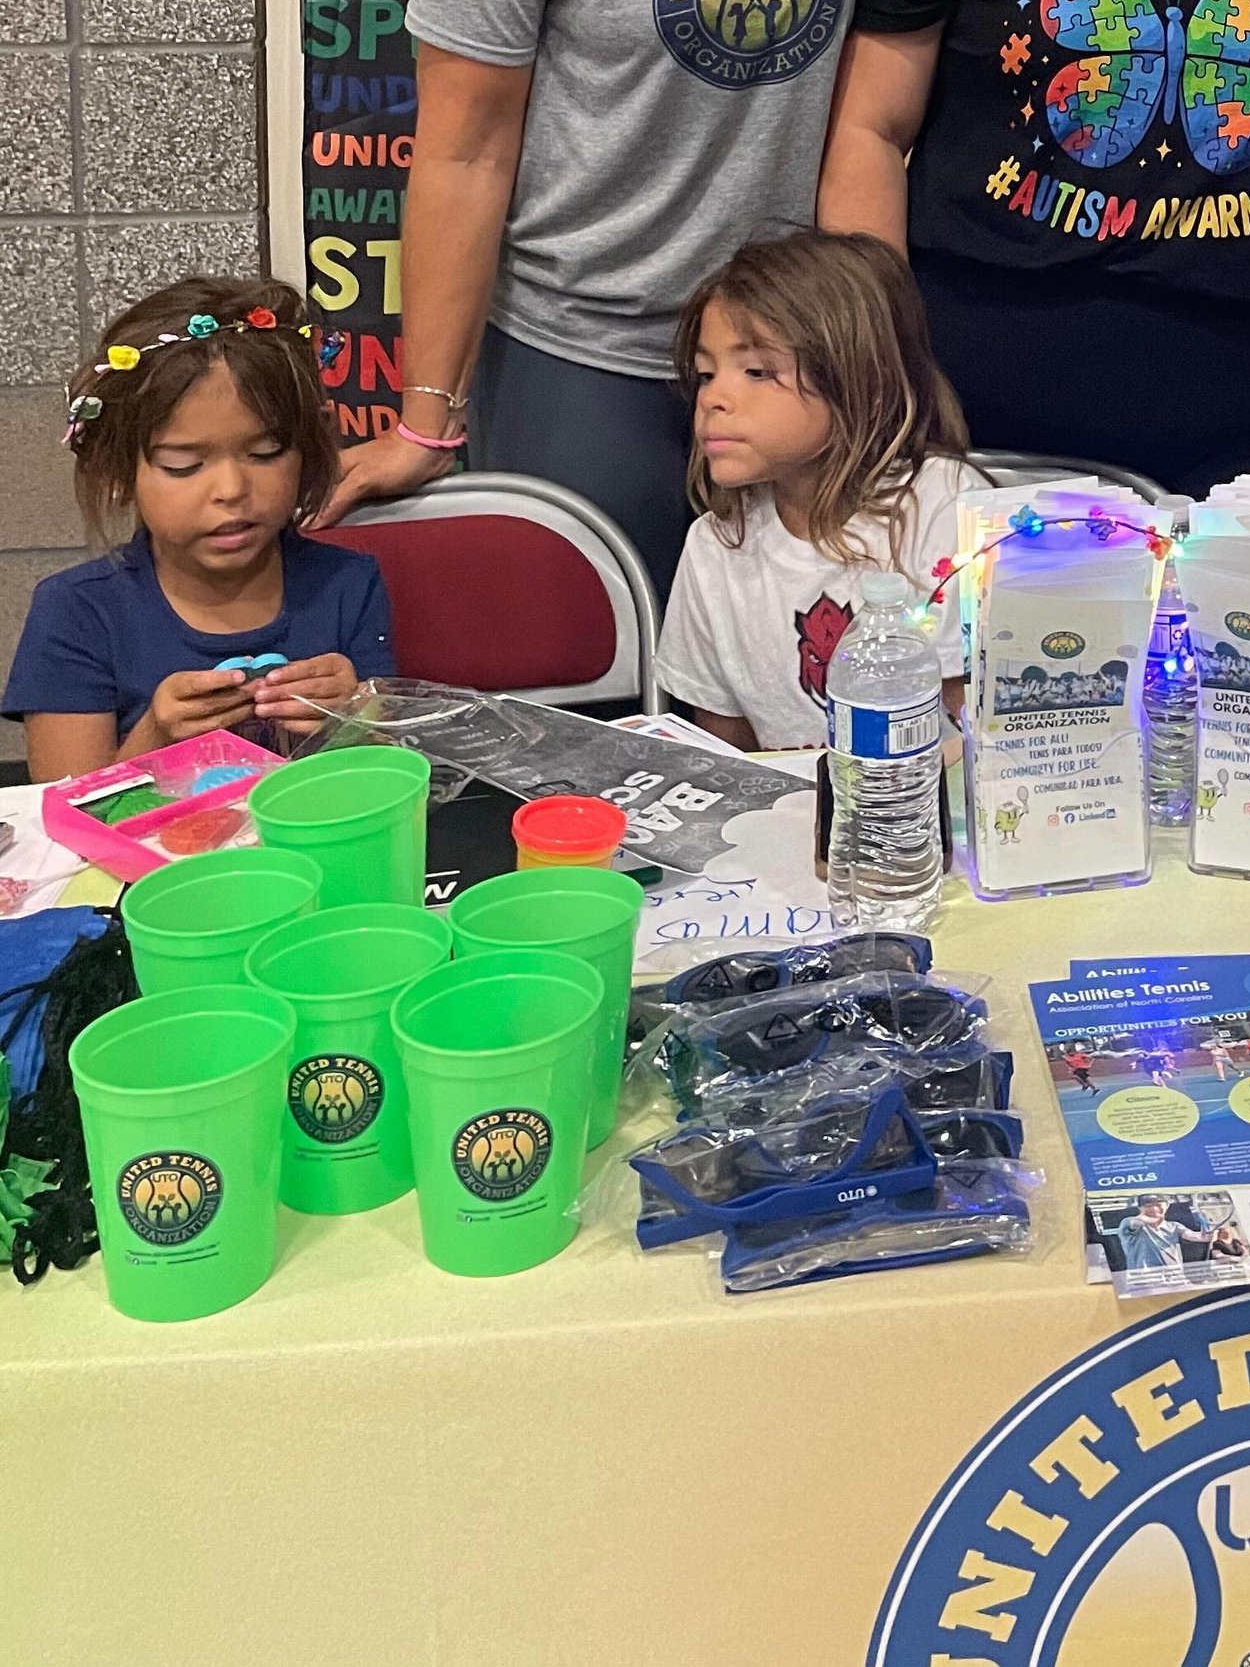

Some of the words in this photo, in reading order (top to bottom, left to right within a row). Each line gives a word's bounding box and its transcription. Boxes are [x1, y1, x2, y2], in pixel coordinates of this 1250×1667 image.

[985, 155, 1137, 241] #AUTISM
[1004, 716, 1110, 732] ORGANIZATION
[1009, 713, 1056, 722] UNITED
[1061, 709, 1107, 718] TENNIS
[1047, 987, 1136, 1004] Abilities
[1140, 979, 1210, 996] Tennis
[1055, 1018, 1177, 1037] OPPORTUNITIES
[1180, 1015, 1211, 1026] FOR
[1215, 1011, 1248, 1023] YOU
[292, 1058, 330, 1097] UNITED
[335, 1058, 380, 1094] TENNIS
[457, 1114, 500, 1158] UNITED
[122, 1156, 162, 1198] UNITED
[169, 1155, 218, 1192] TENNIS
[1097, 1171, 1158, 1187] GOALS
